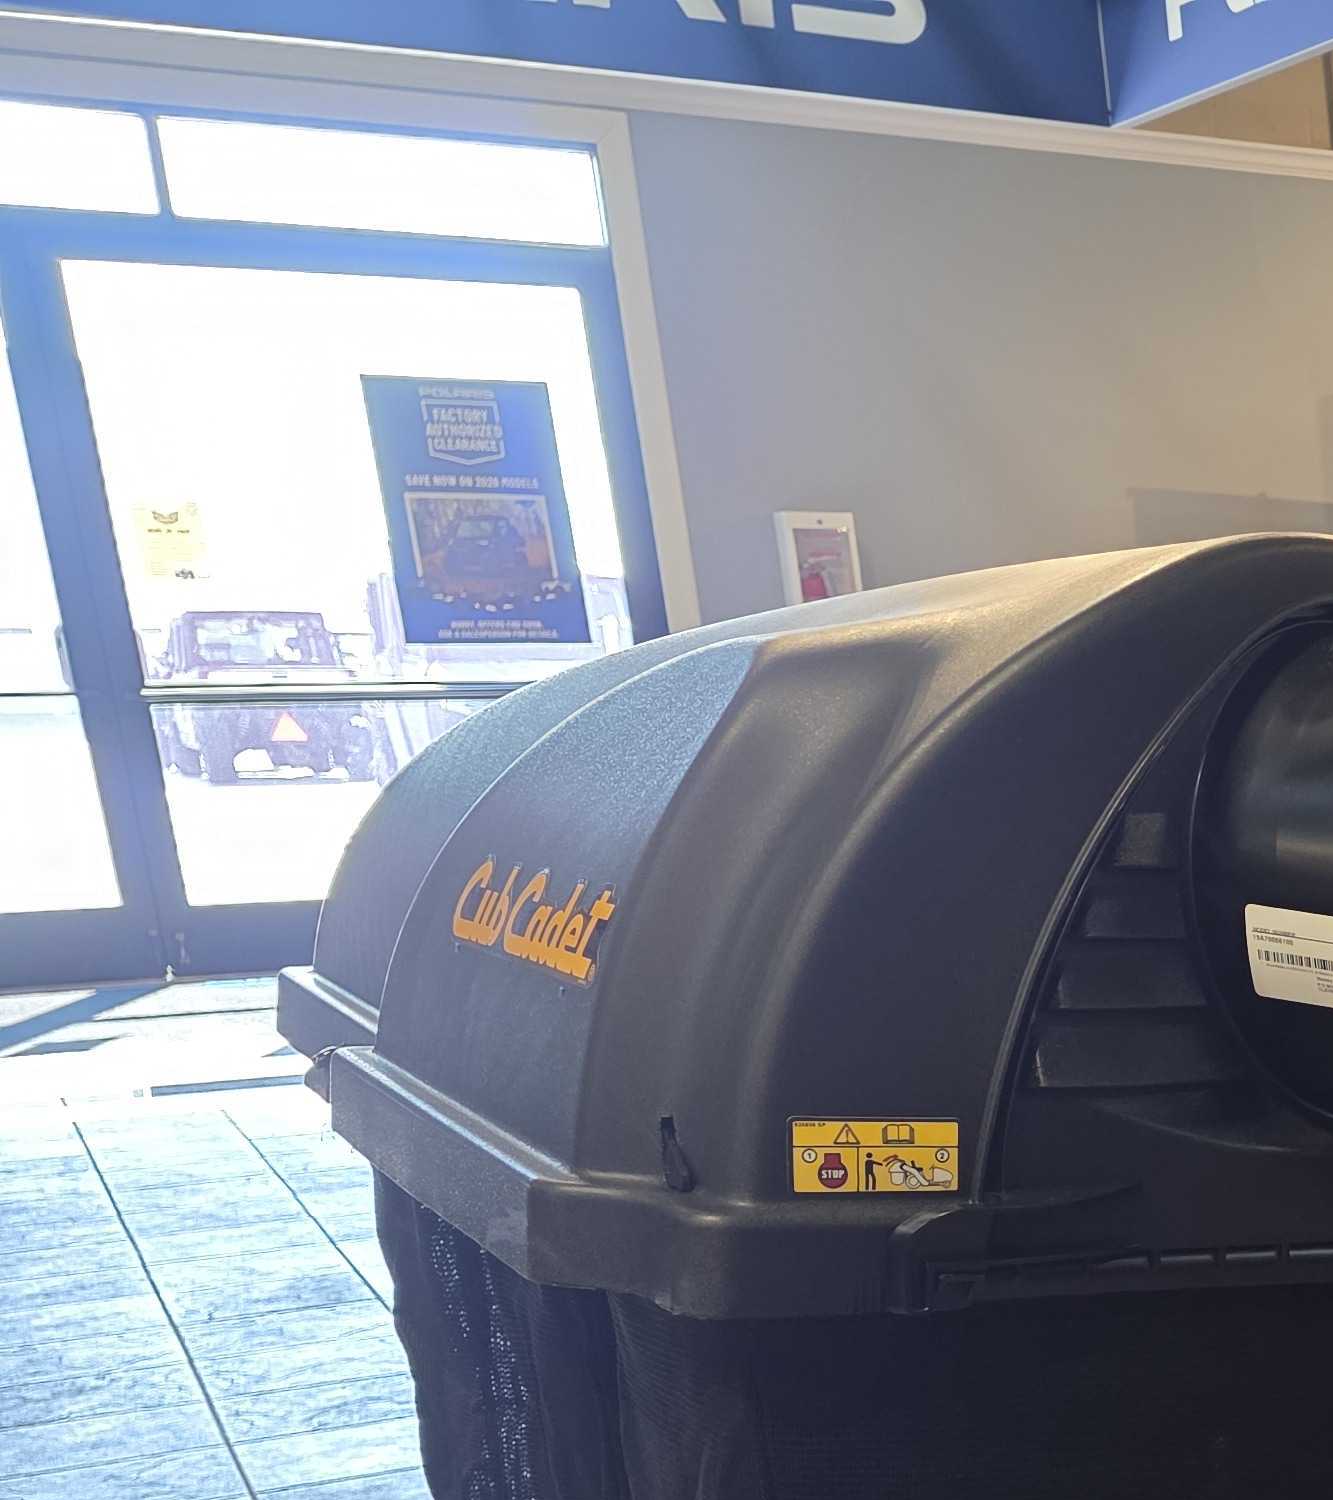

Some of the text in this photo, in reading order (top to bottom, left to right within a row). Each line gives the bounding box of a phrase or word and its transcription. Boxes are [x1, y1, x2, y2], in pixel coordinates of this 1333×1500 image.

[432, 408, 488, 423] FACTORY
[426, 424, 504, 438] AUTHORIZED
[434, 438, 499, 452] CLEARANCE
[452, 860, 615, 980] Cub Cadet
[821, 1168, 845, 1179] STOP
